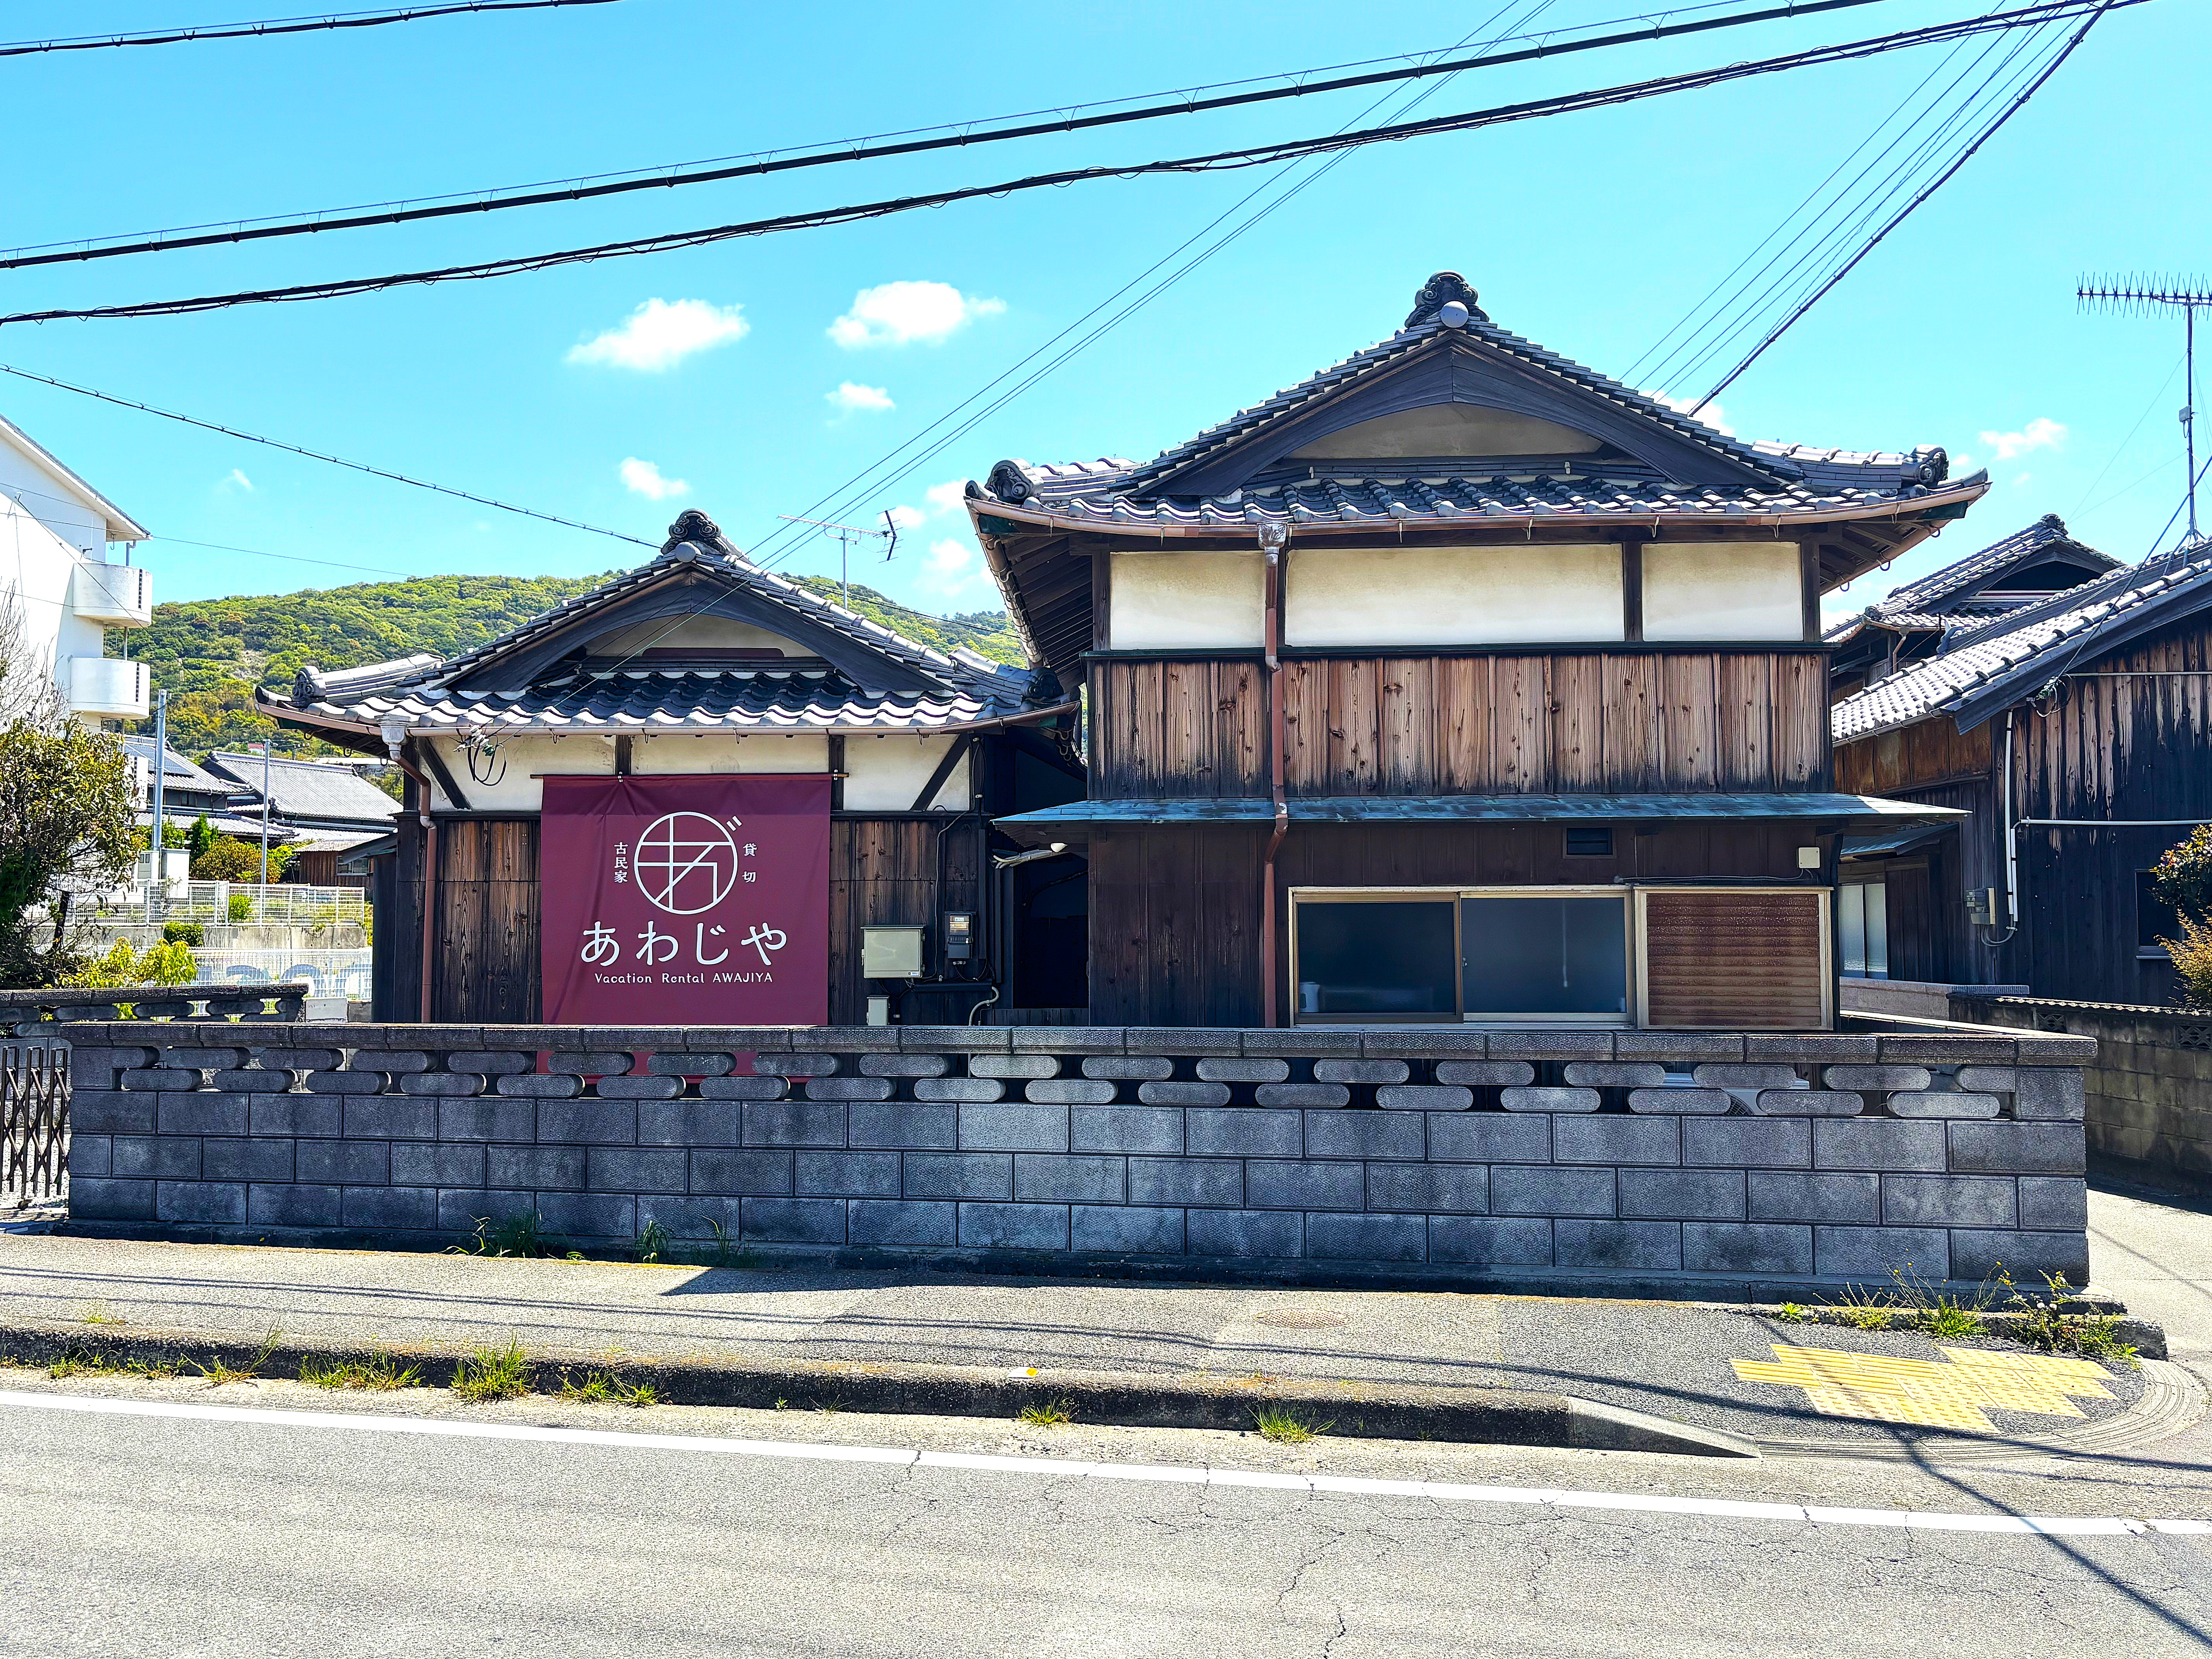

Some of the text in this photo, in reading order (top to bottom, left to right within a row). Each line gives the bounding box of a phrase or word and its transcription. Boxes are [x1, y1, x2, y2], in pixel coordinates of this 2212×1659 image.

[614, 842, 628, 883] 古民家
[742, 843, 757, 883] 貸切
[581, 921, 787, 966] あわじや
[595, 972, 773, 984] Vacation Rental AWAJIYA
